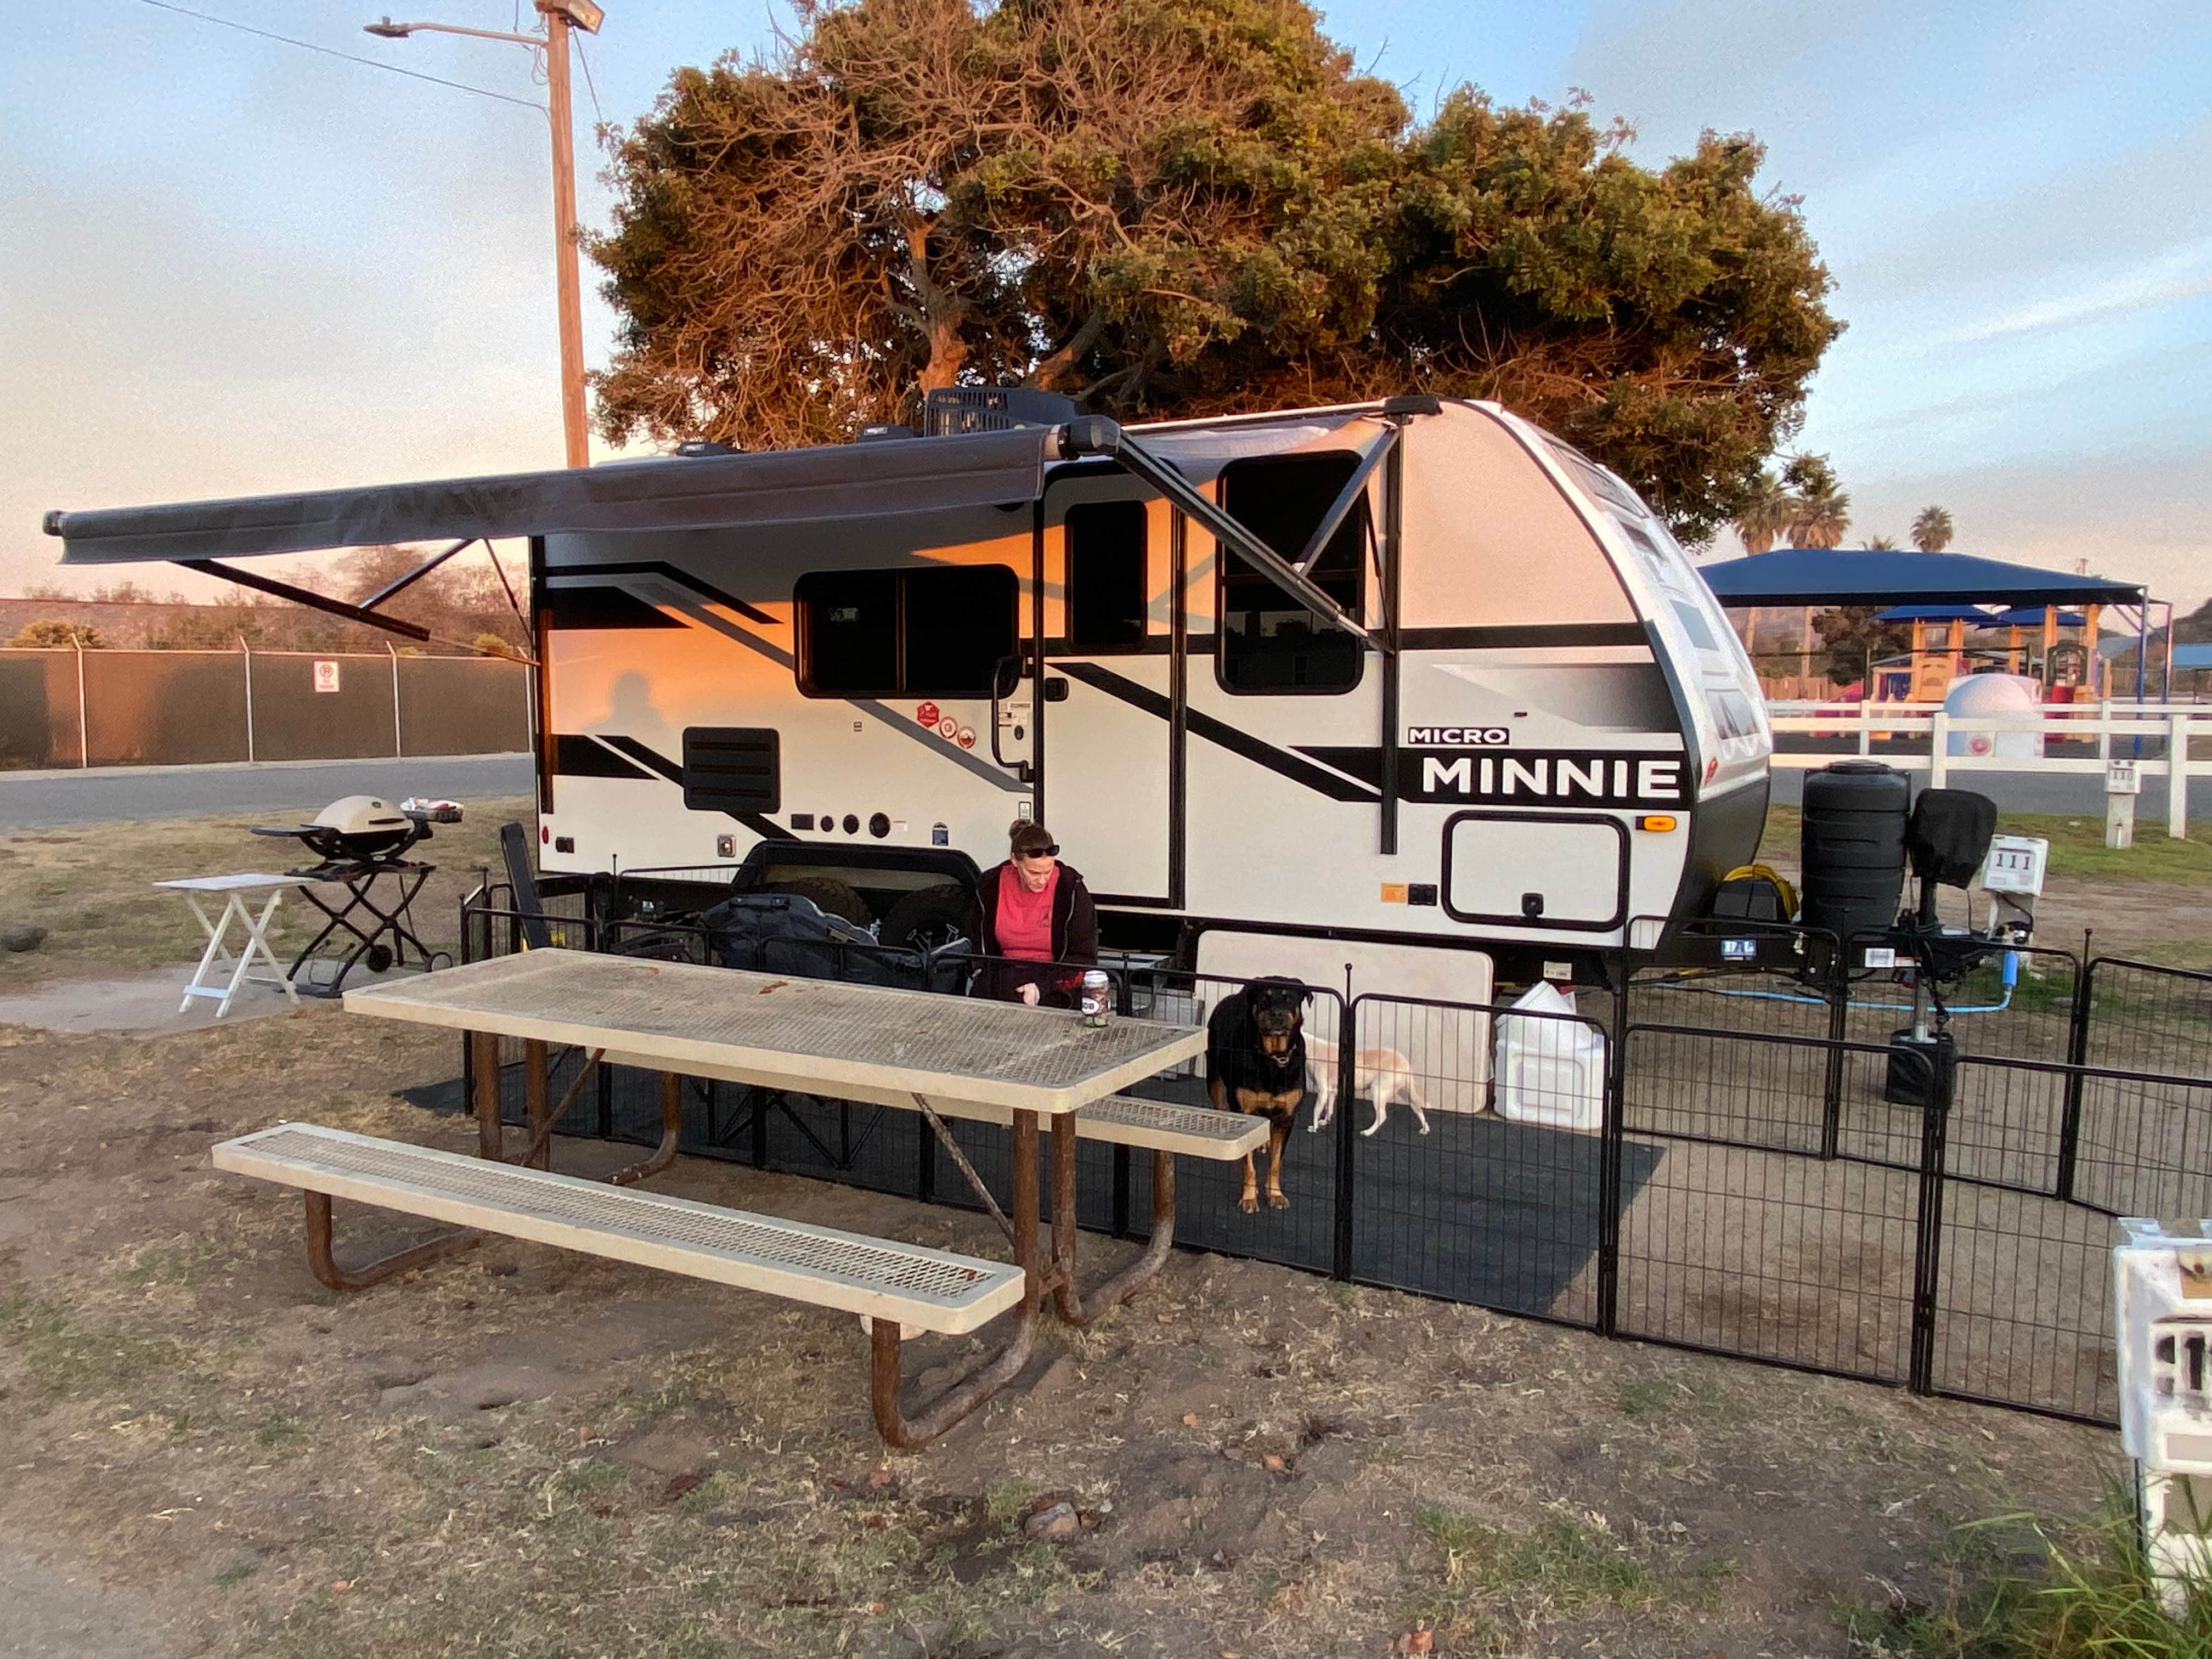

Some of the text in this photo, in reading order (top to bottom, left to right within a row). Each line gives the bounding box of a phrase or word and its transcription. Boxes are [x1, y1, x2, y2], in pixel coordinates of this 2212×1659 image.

[1409, 729, 1507, 744] MICRO
[1423, 757, 1681, 798] MINNIE
[2113, 771, 2134, 781] 110
[1996, 853, 2030, 871] 111
